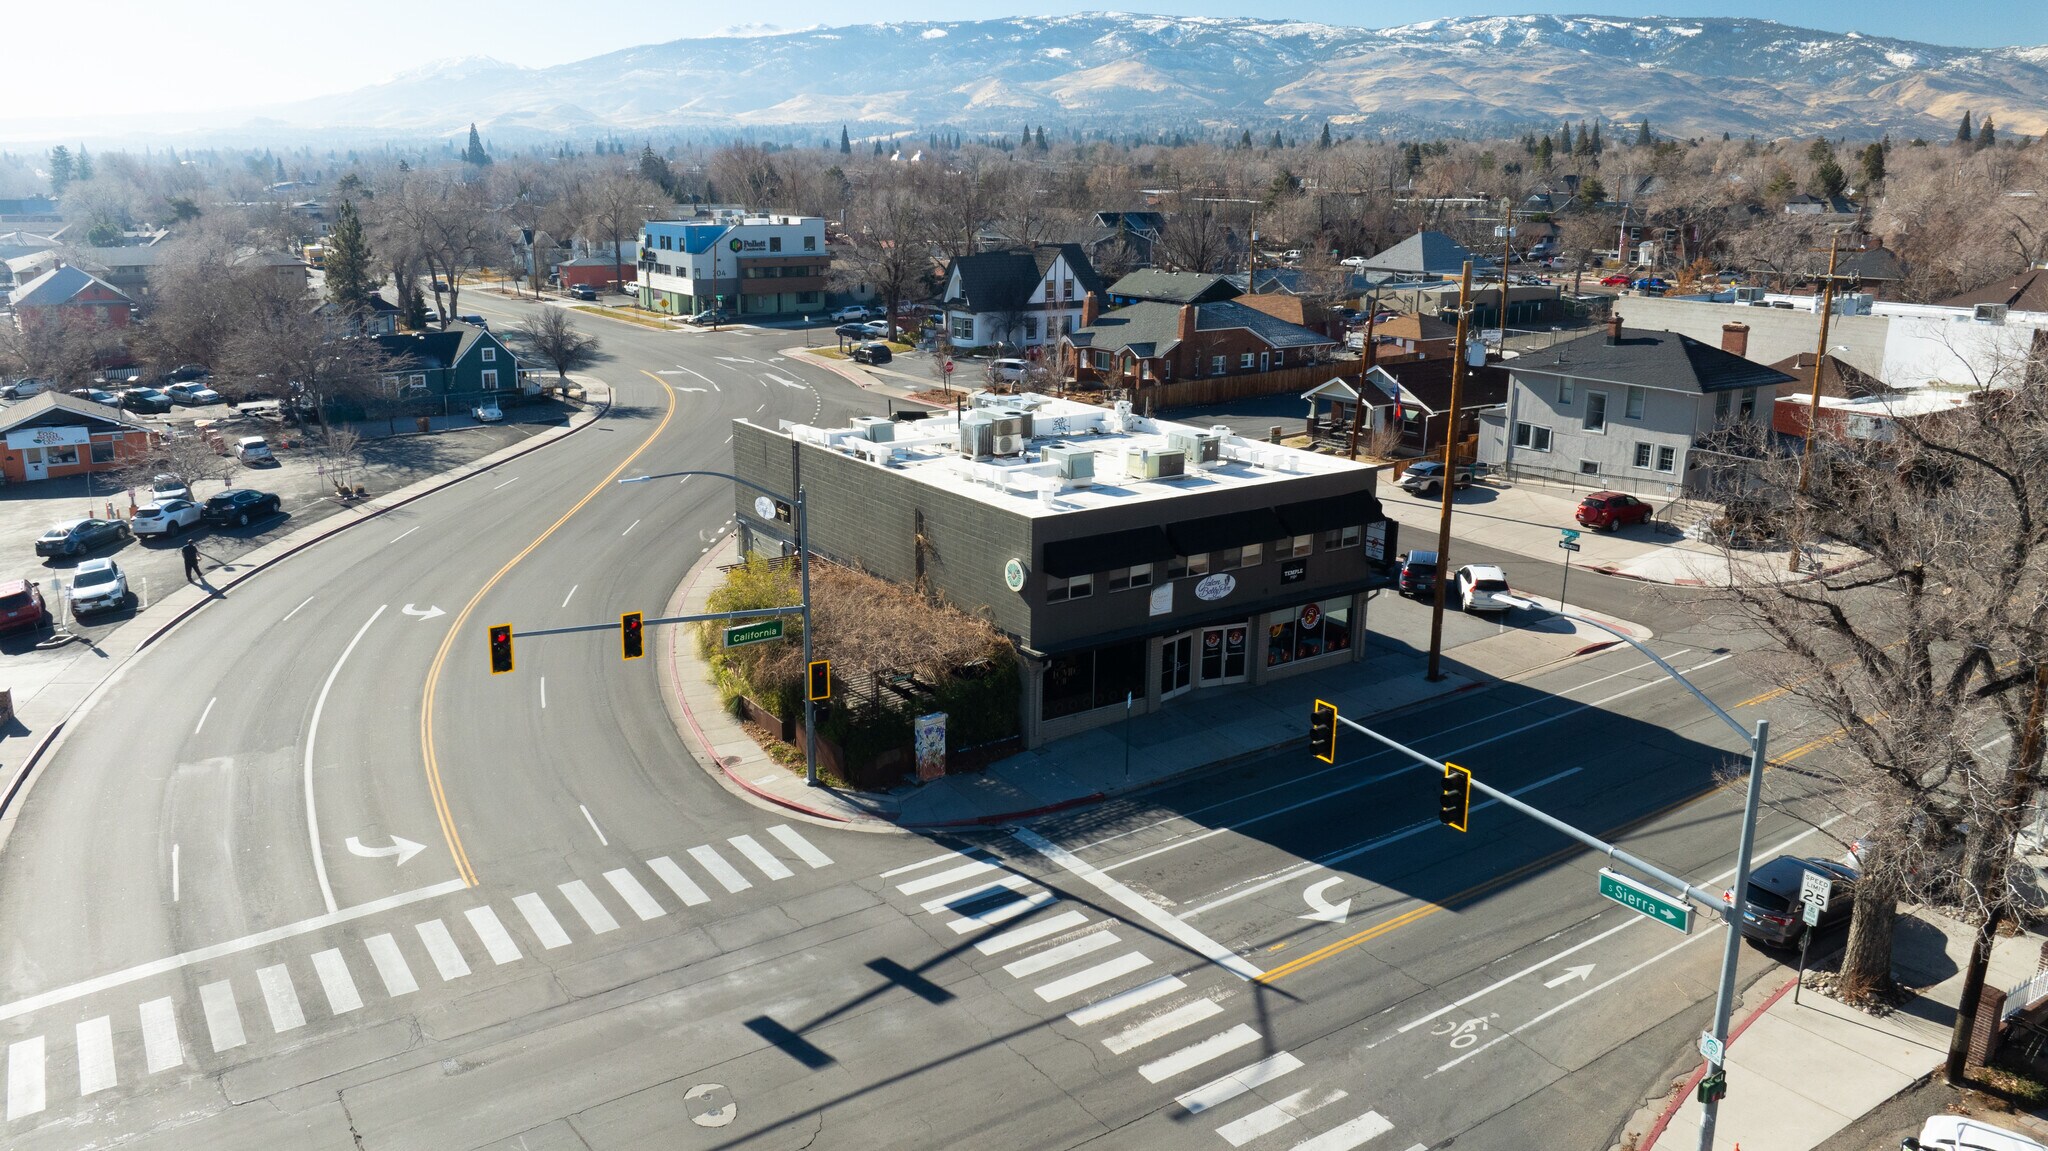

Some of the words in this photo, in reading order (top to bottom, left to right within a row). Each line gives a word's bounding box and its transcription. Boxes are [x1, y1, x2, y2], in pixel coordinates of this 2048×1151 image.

[1284, 568, 1304, 577] TEMPLE
[733, 628, 777, 642] California
[1805, 874, 1828, 888] SPEED
[1806, 881, 1825, 893] LIMIT
[1608, 884, 1613, 892] S
[1615, 885, 1656, 915] Sierra
[1803, 889, 1825, 907] 25
